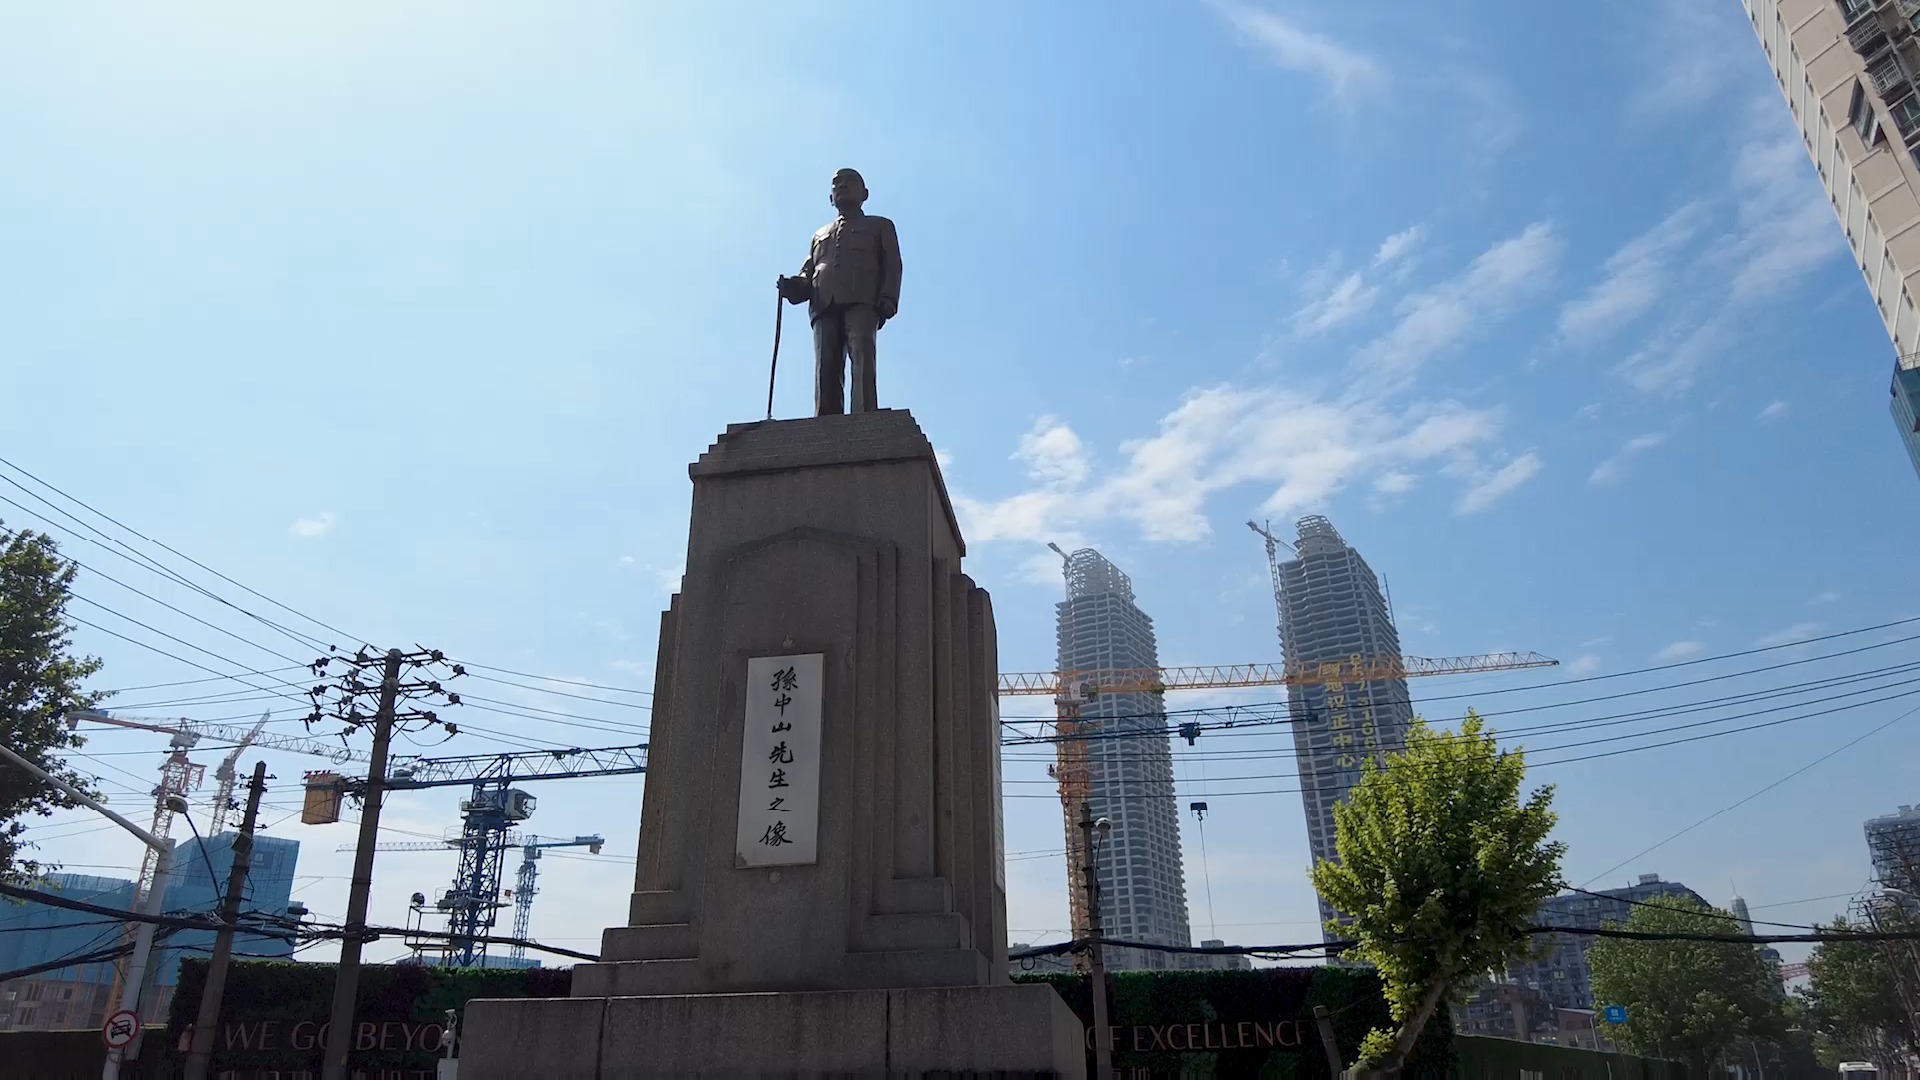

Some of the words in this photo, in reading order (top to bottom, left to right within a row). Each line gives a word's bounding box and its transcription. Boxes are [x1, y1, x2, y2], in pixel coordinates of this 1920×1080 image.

[758, 665, 799, 847] 孫中山先生之像
[224, 1020, 280, 1051] WE
[355, 1020, 445, 1053] BEYO
[1133, 1019, 1308, 1053] EXCELLENCE
